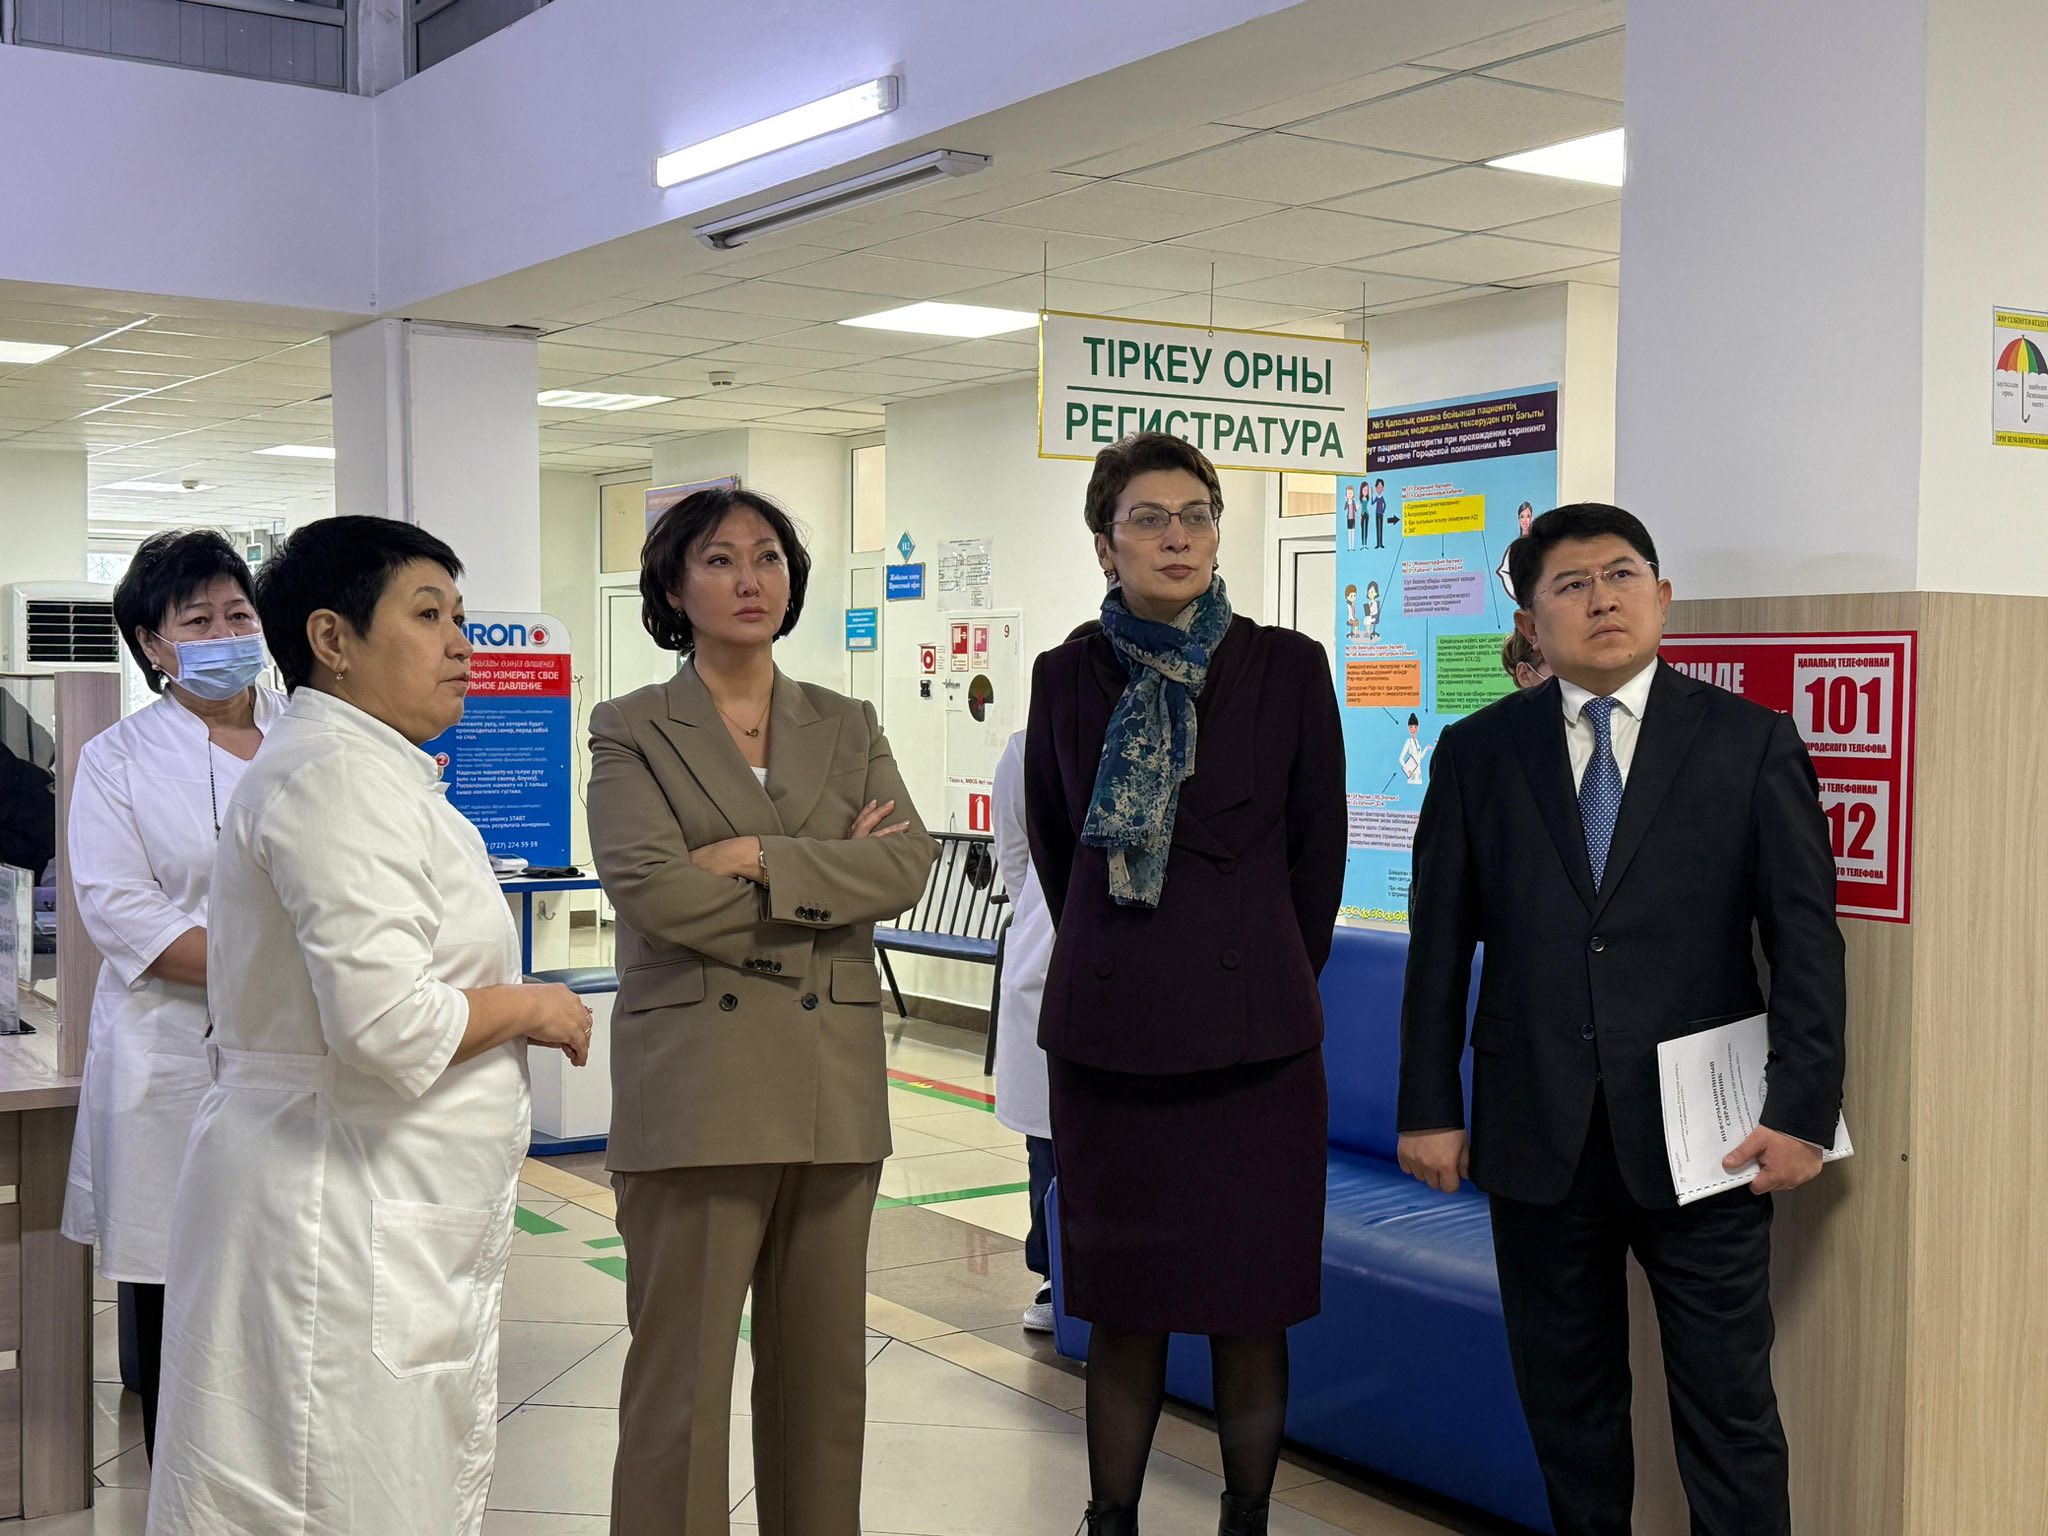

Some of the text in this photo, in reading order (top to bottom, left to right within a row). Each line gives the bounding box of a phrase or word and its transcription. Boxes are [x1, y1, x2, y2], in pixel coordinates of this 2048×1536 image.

[1083, 337, 1332, 395] ТІРКЕУ ОРНЫ
[1385, 417, 1416, 428] Қалалық
[1416, 413, 1442, 424] емхана
[1442, 408, 1476, 420] бойынша
[1066, 402, 1344, 458] РЕГИСТРАТУРА
[1444, 436, 1458, 446] при
[1458, 429, 1507, 444] прохождении
[1507, 423, 1546, 436] скрининга
[1386, 453, 1412, 464] уровне
[1412, 445, 1449, 459] Городской
[1450, 442, 1498, 454] поликлиники
[1498, 437, 1511, 448] №5
[1004, 624, 1010, 638] 9
[1798, 657, 1890, 669] ҚАЛАЛЫҚ ТЕЛЕФОННАН
[493, 671, 536, 679] ИЗМЕРЬТЕ
[538, 671, 559, 680] СВОЕ
[497, 682, 543, 691] ДАВЛЕНИЕ
[1805, 676, 1881, 734] 101
[1806, 742, 1887, 754] ОРОДСКОГО ТЕЛЕФОНА
[1827, 783, 1878, 795] ТЕЛЕФОННАН
[1818, 801, 1876, 860] 12
[1847, 868, 1884, 879] ТЕЛЕФОНА
